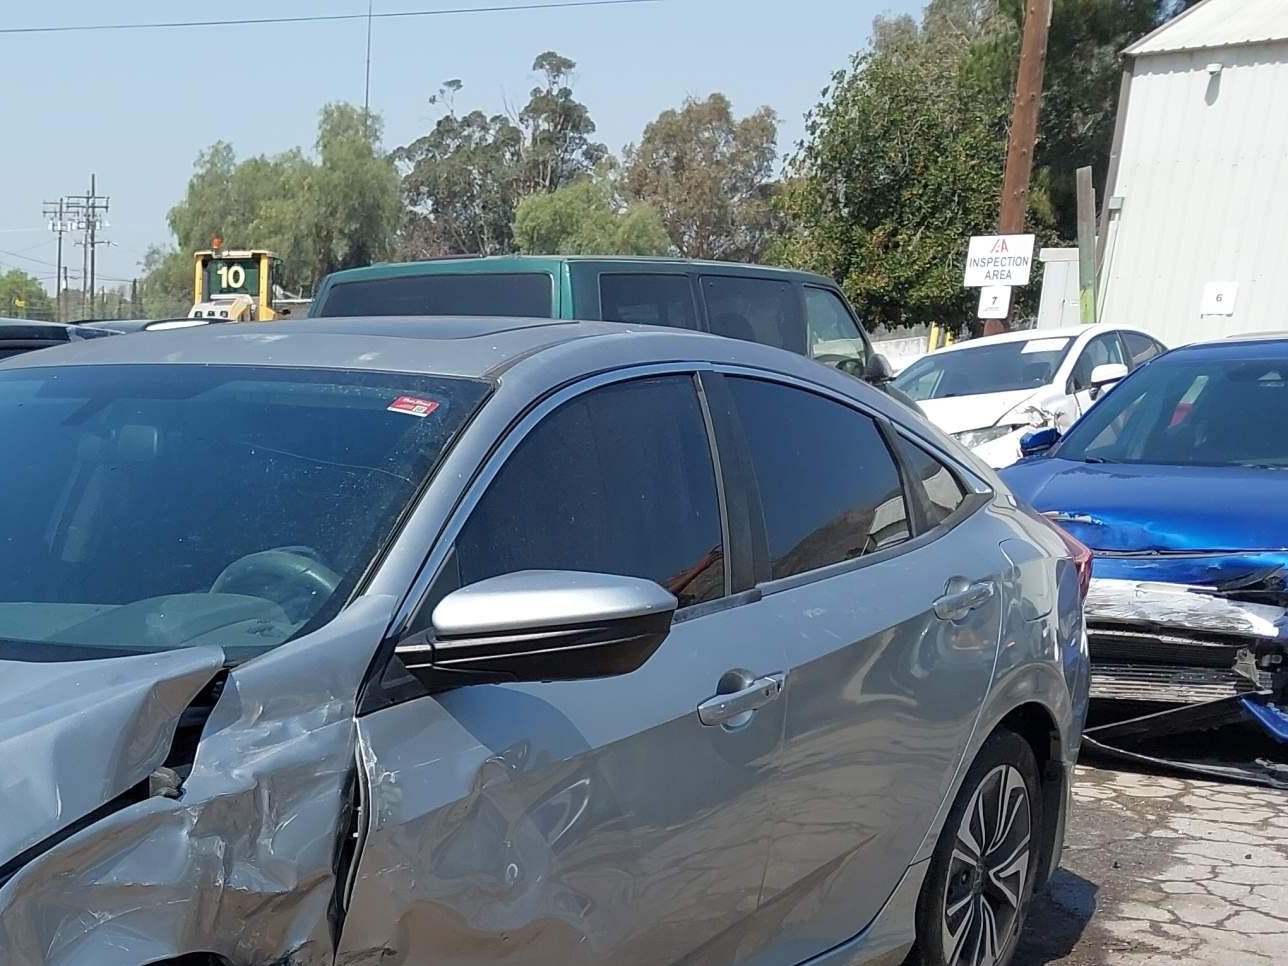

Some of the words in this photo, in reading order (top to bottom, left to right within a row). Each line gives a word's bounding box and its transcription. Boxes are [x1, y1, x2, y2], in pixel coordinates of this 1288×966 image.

[969, 256, 1029, 268] INSPECTION
[217, 265, 245, 288] 10
[984, 269, 1012, 280] AREA
